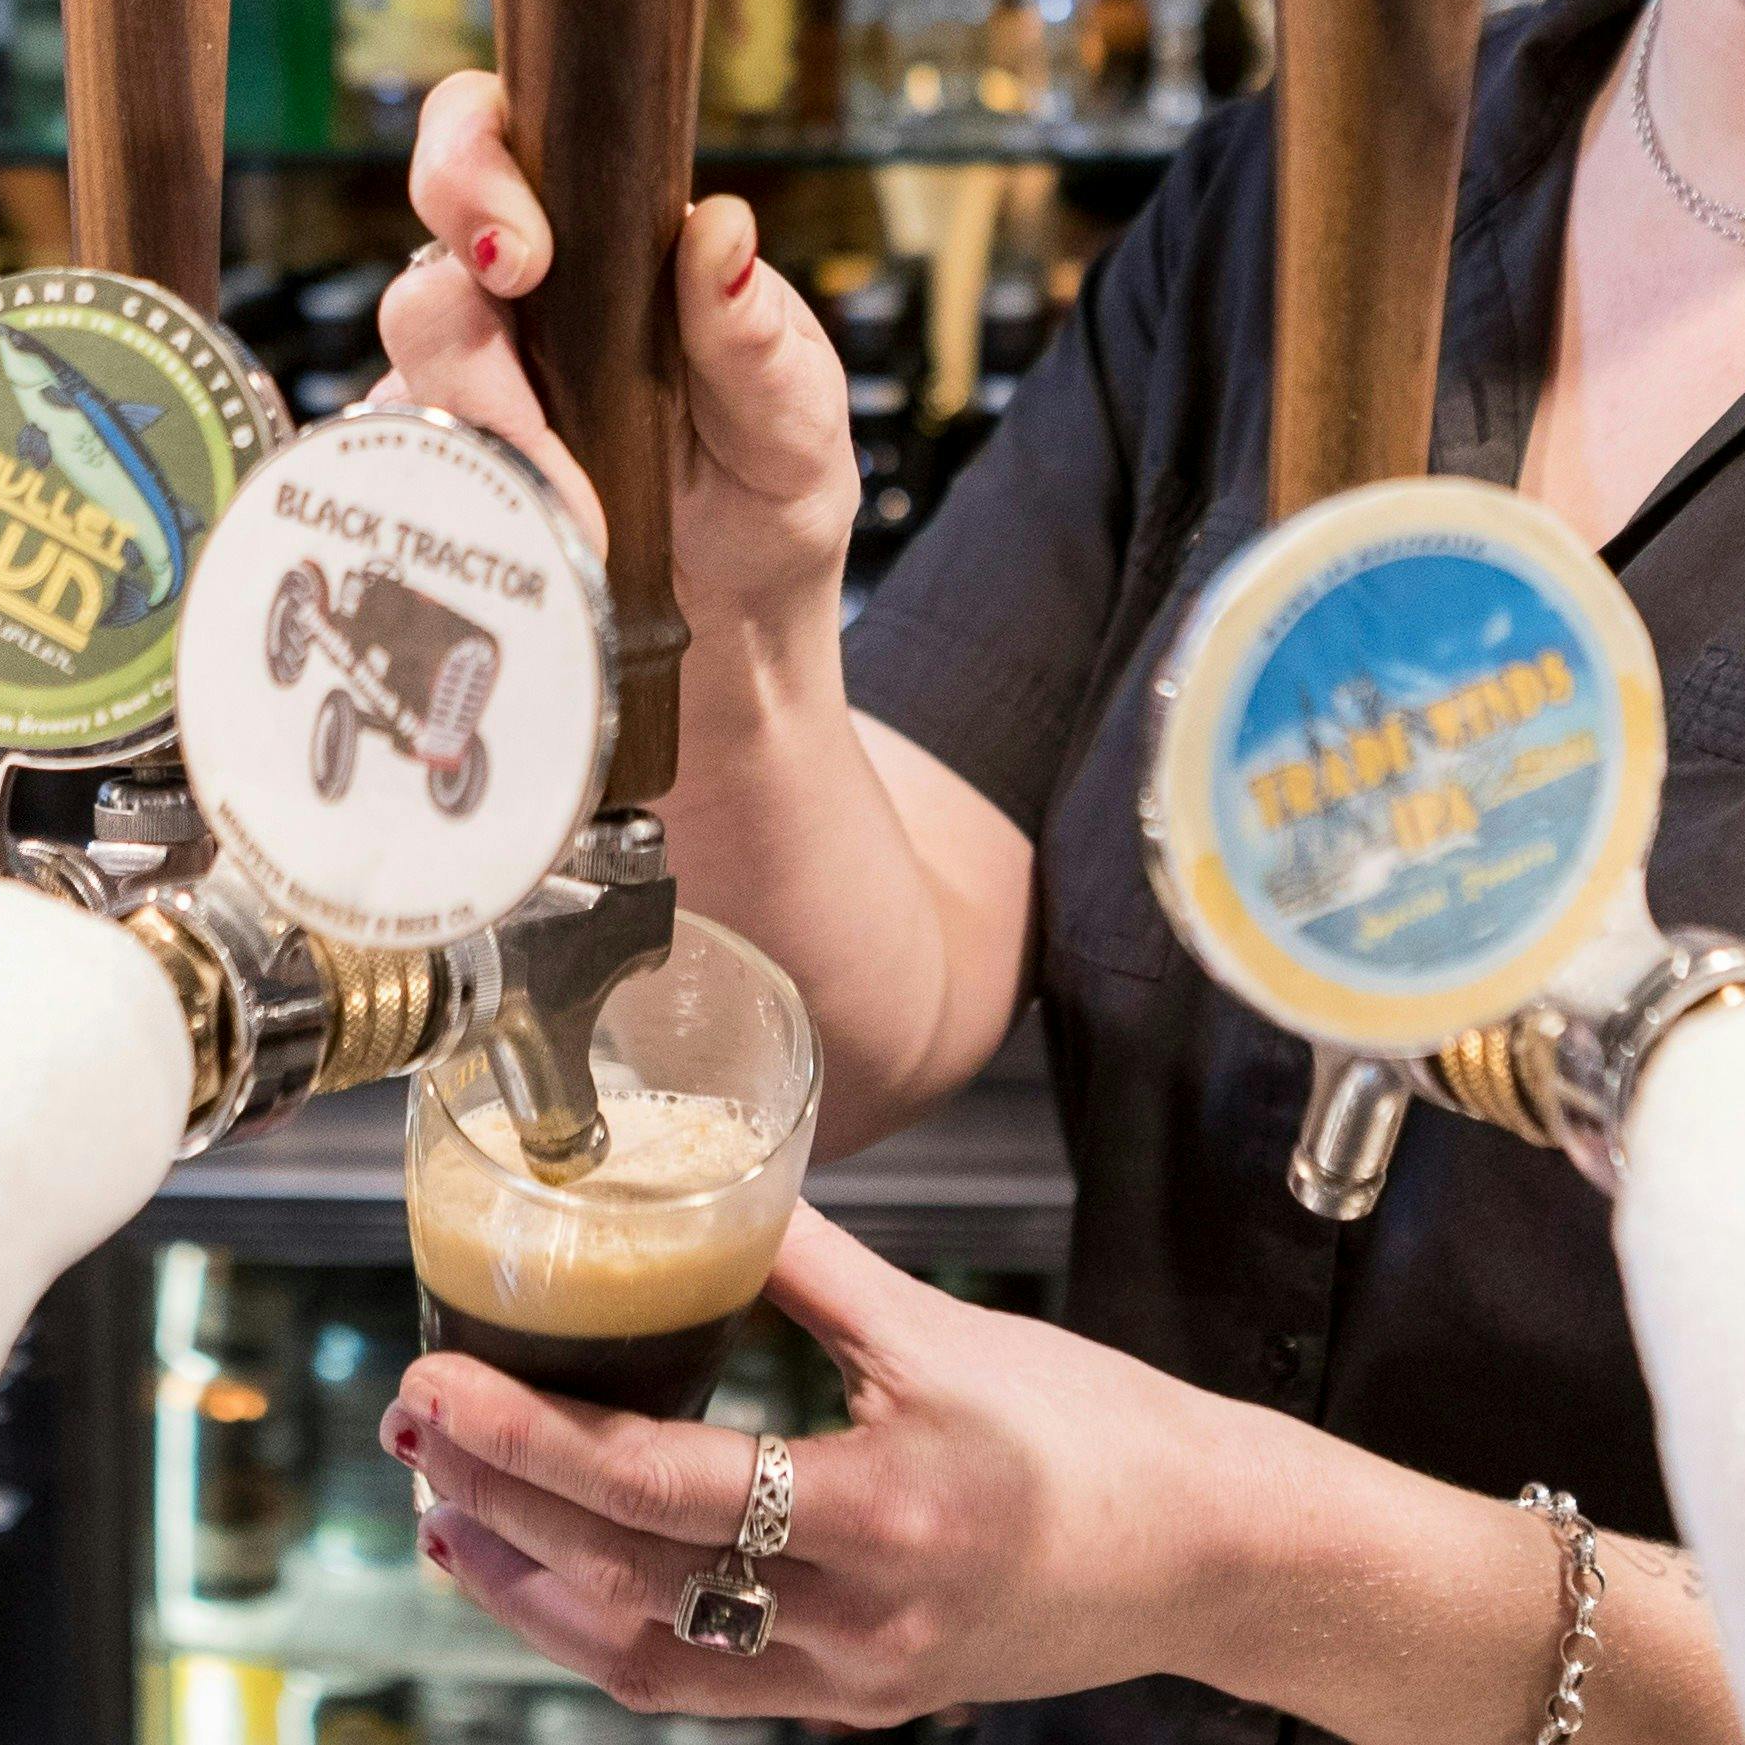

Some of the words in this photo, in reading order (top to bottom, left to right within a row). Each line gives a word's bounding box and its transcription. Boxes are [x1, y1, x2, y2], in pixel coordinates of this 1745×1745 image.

[122, 295, 254, 449] CRAFTED
[274, 481, 381, 549] BLACK
[395, 522, 548, 610] TRACTOR
